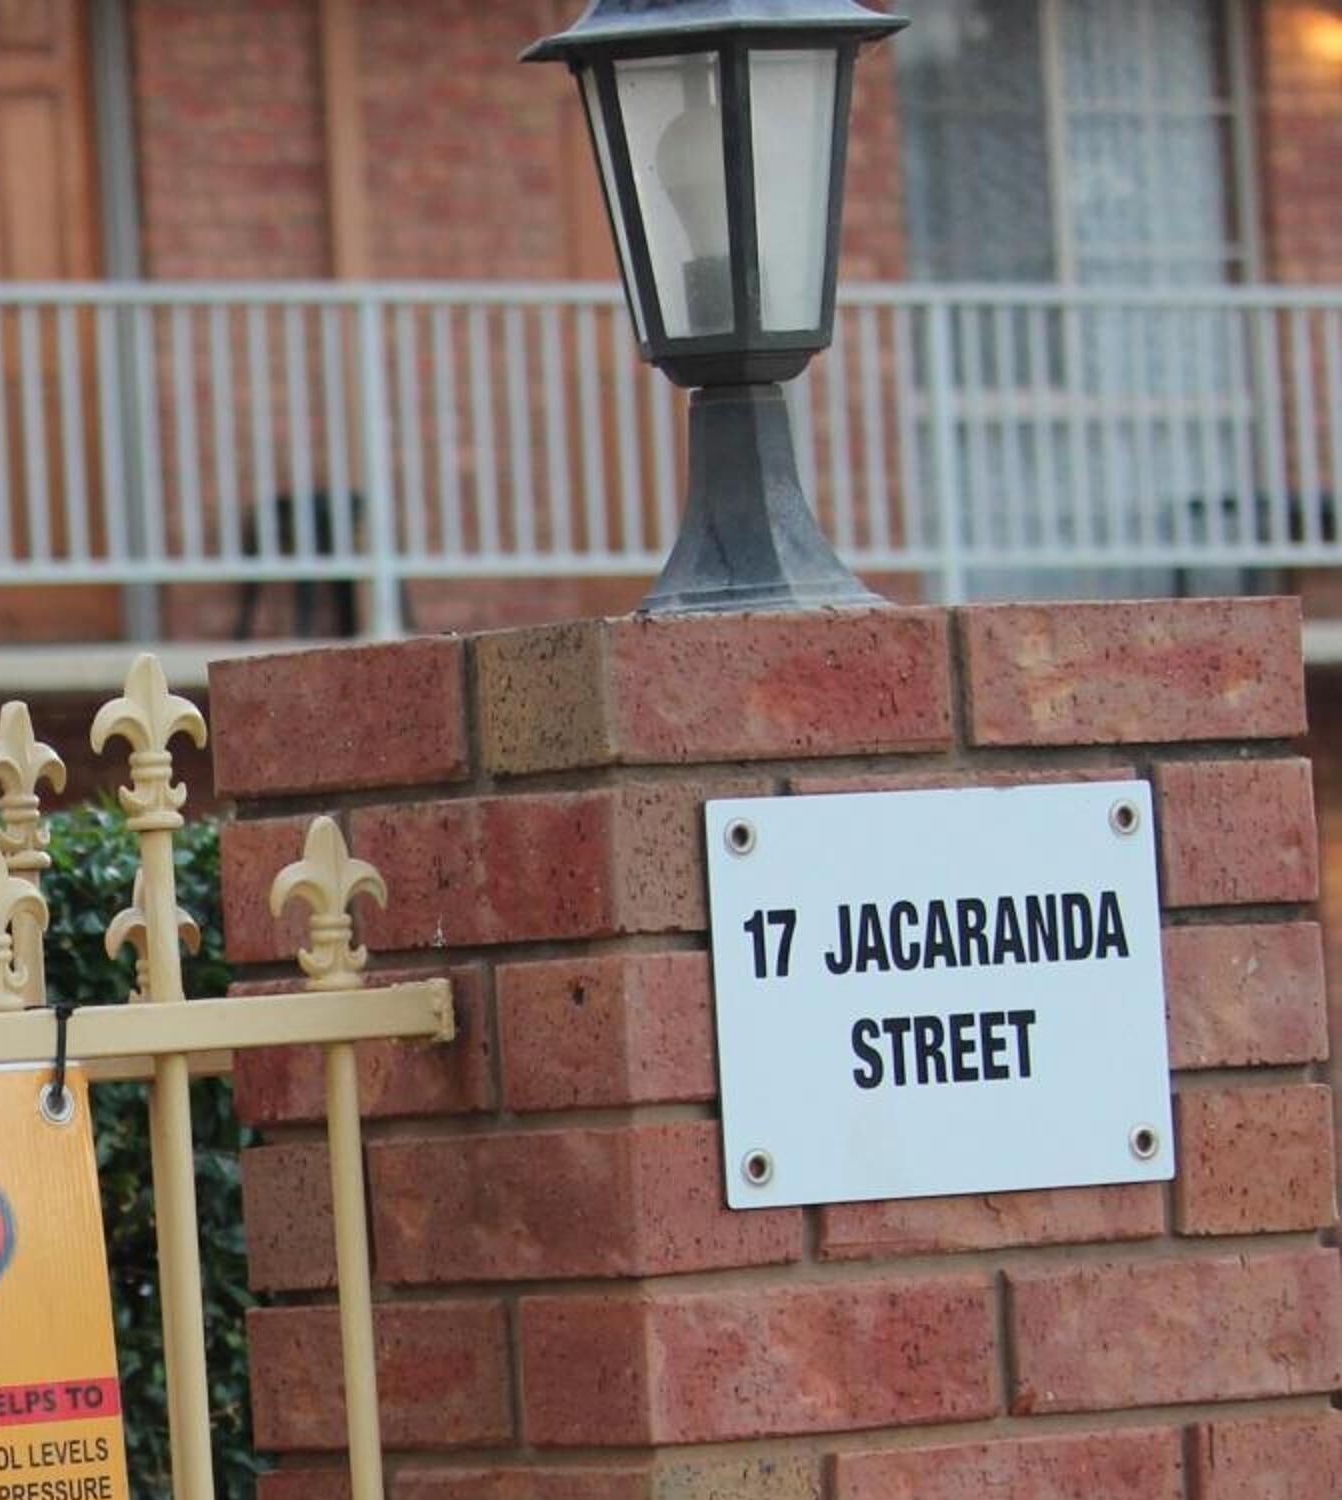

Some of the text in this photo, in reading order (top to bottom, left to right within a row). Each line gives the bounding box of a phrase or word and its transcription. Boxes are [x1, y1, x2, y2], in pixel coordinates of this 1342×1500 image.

[743, 890, 1130, 979] 17 JACARANDA
[851, 1009, 1036, 1090] STREET
[65, 1385, 103, 1409] TO
[28, 1437, 109, 1468] LEVELS
